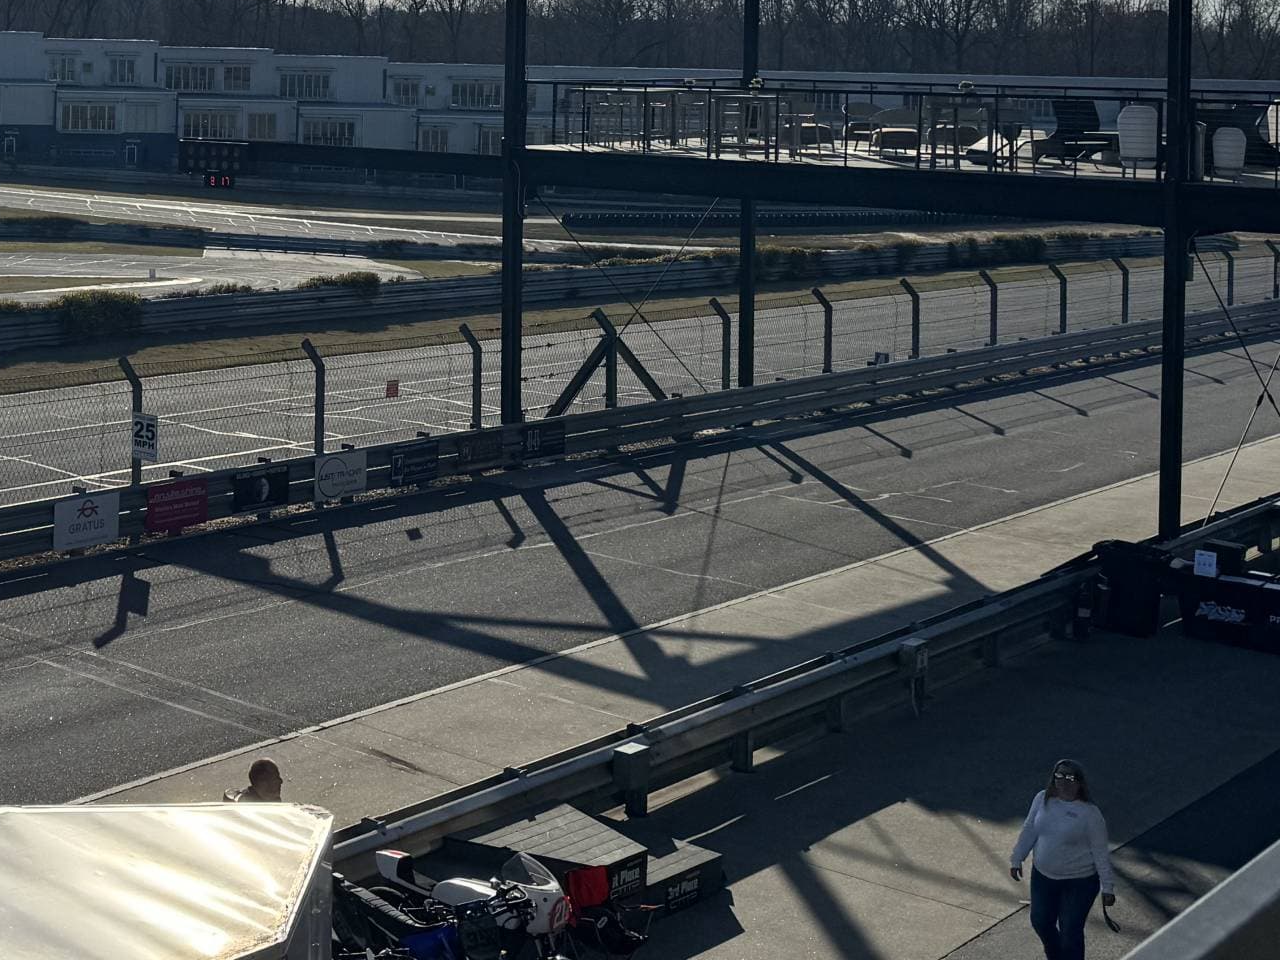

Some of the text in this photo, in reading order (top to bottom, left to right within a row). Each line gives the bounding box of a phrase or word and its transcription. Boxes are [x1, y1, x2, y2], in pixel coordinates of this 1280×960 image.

[134, 420, 155, 442] 25
[134, 439, 155, 450] MPH
[68, 518, 105, 534] GRATUS
[620, 867, 641, 886] Place
[667, 883, 680, 901] 3rd
[680, 877, 699, 895] Place
